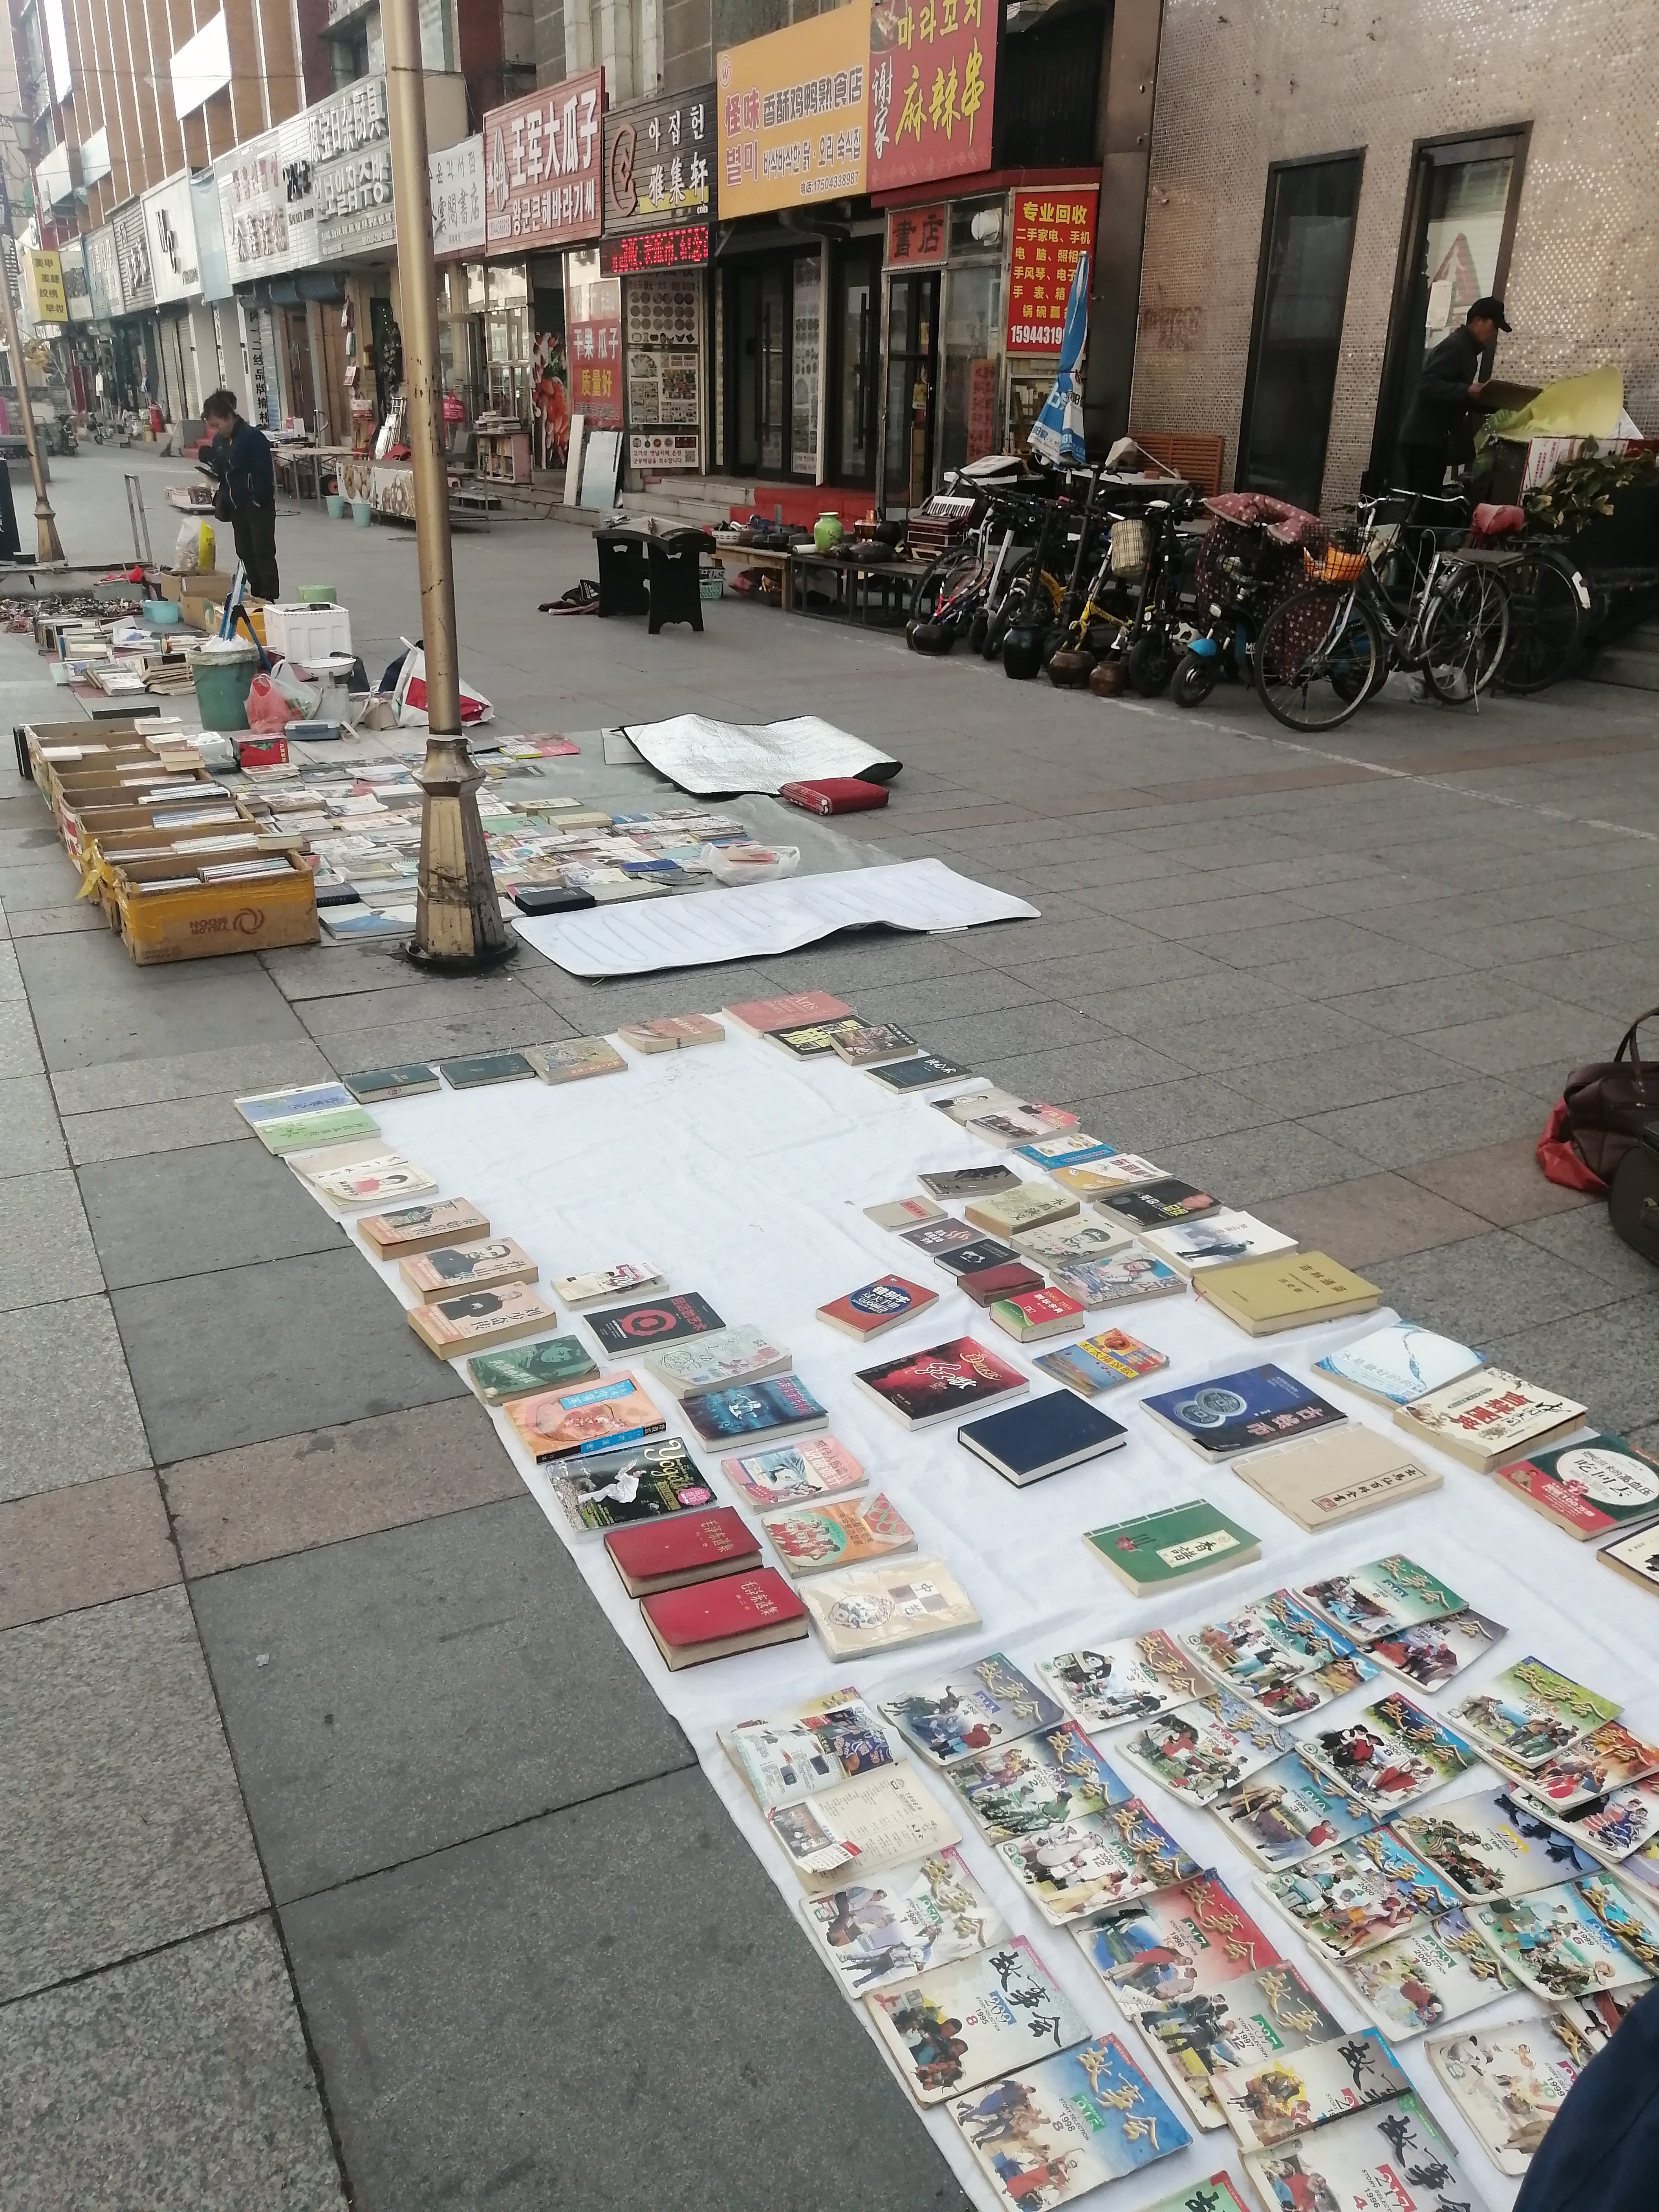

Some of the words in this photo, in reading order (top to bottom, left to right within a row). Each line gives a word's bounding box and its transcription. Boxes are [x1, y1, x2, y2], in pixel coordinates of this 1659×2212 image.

[724, 87, 760, 138] 怪味
[764, 66, 864, 129] 香酥鸡鸭熟食店
[895, 37, 985, 148] 麻辣串
[872, 55, 893, 159] 谢家
[512, 89, 598, 187] 王军大瓜子
[649, 104, 704, 152] 아집헌
[725, 139, 758, 186] 별미
[763, 142, 800, 179] 바삭바삭한
[803, 140, 811, 172] 닭
[818, 134, 835, 168] 오리
[648, 151, 708, 207] 雅集轩
[1022, 201, 1088, 225] 专业回收
[893, 214, 943, 258] 書店
[1016, 228, 1091, 245] 二手家电、手机
[35, 258, 53, 268] 美甲
[1015, 247, 1086, 263] 电脑、照相
[573, 328, 618, 360] 干果瓜子
[581, 369, 612, 397] 质量好
[190, 917, 228, 928] MOON
[790, 996, 820, 1011] Arts
[1009, 1198, 1068, 1221] 永昌演义
[1138, 1194, 1161, 1205] 死囚
[416, 1218, 479, 1236] 秦始皇传
[455, 1259, 527, 1280] 孙中山传
[858, 1298, 890, 1312] CUOBIEZI
[873, 1285, 911, 1305] 错别字
[1034, 1294, 1064, 1314] 新华字典
[471, 1306, 546, 1331] 刘少奇传
[670, 1296, 707, 1331] 回话的艺术
[914, 1362, 977, 1390] 红歌
[1246, 1406, 1324, 1436] 古钱币
[805, 1449, 845, 1487] 识破诡计
[813, 1439, 853, 1483] 现代人的诡计
[701, 1520, 734, 1553] 毛泽东选集
[741, 1580, 778, 1616] 毛泽东选集
[915, 1582, 934, 1594] 中
[1135, 1635, 1196, 1697] 故事会
[974, 1661, 1042, 1723] 故事会
[1514, 1665, 1607, 1720] 故事会
[1380, 1699, 1469, 1768] 故事会
[1383, 1748, 1394, 1757] 8
[1385, 1743, 1402, 1757] 2000
[1046, 1730, 1111, 1805] 故事会
[1028, 1779, 1039, 1789] 2
[1034, 1773, 1048, 1789] 2000
[1113, 1807, 1182, 1880] 故事会
[1092, 1855, 1106, 1868] 12
[1099, 1852, 1114, 1866] 2000
[1355, 1888, 1364, 1897] 4
[1357, 1882, 1375, 1897] 2000
[919, 1857, 987, 1947] 故事会
[899, 1916, 908, 1924] 1
[907, 1909, 919, 1925] 1999
[1180, 1881, 1257, 1971] 故事会
[1170, 1932, 1185, 1948] 1998
[1571, 1937, 1583, 1946] 6
[1577, 1930, 1595, 1946] 1999
[1415, 1950, 1432, 1968] 2000
[1423, 1952, 1448, 1976] SELECTION
[984, 1990, 1017, 2027] 209
[989, 1951, 1062, 2048] 故事会
[1256, 1971, 1324, 2044] 故事
[965, 2015, 979, 2026] 8
[976, 2008, 989, 2025] 1995
[983, 2008, 1001, 2033] SELECTION
[1232, 2036, 1247, 2051] 12
[1238, 2031, 1254, 2048] 1997
[1247, 2034, 1269, 2059] SELECTION
[1076, 2045, 1159, 2150] 故事会
[1538, 2082, 1556, 2098] 10
[1546, 2076, 1565, 2097] 1999
[1051, 2120, 1065, 2132] 8
[1057, 2097, 1072, 2115] STORY
[1069, 2114, 1091, 2141] SELECTION
[1058, 2111, 1076, 2133] 1998
[1361, 2168, 1376, 2188] STORY
[1374, 2163, 1417, 2212] 217
[1352, 2195, 1368, 2210] 4
[1364, 2187, 1381, 2208] 1996
